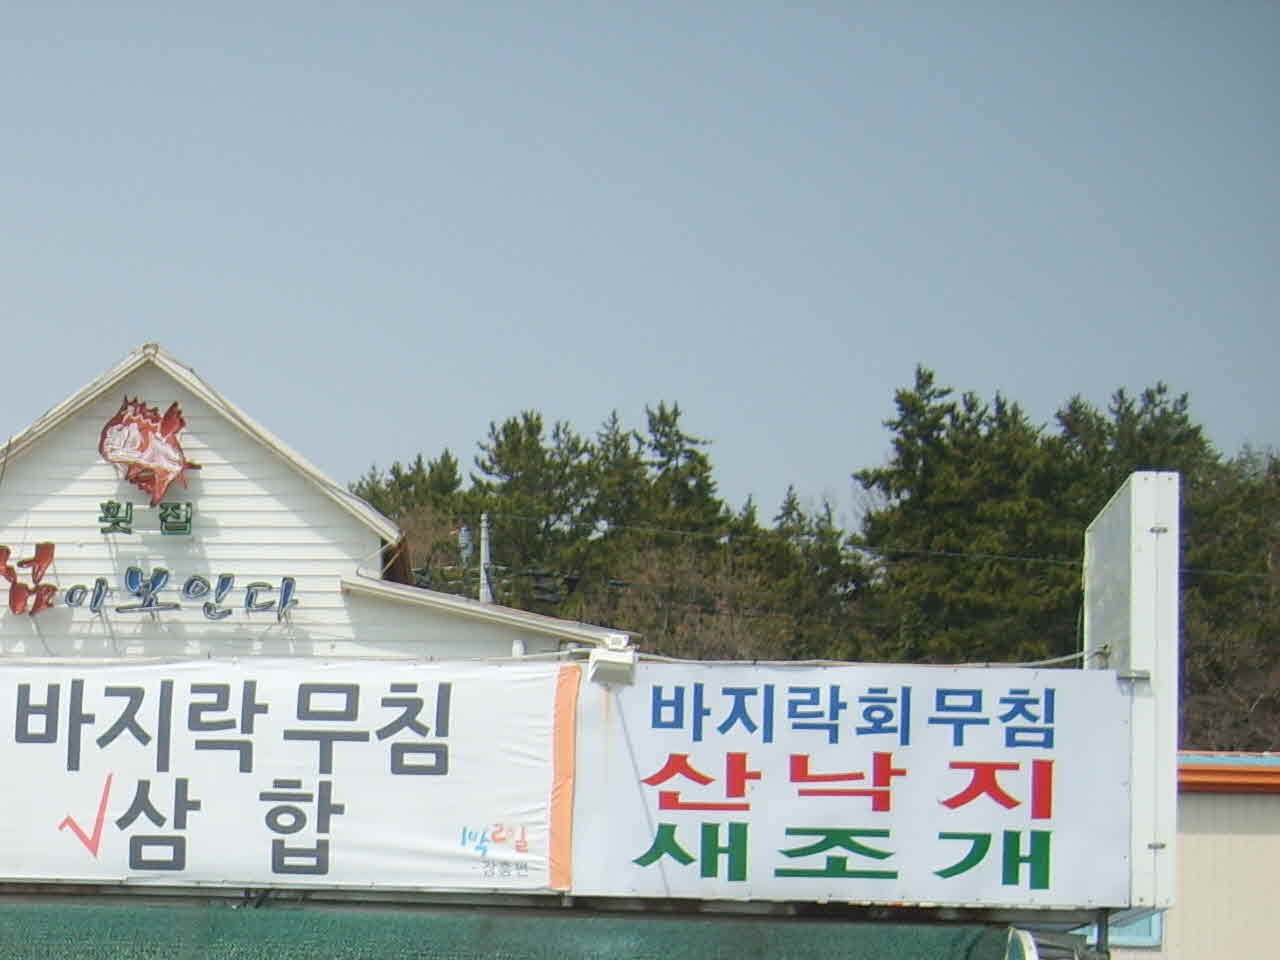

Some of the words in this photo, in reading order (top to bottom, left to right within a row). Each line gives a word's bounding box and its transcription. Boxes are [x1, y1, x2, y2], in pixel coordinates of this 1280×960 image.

[99, 501, 193, 535] 횟집
[14, 679, 452, 776] 바지락무침
[650, 683, 1056, 749] 바지락회무침
[641, 751, 1054, 820] 산낙지
[632, 823, 1052, 890] 새조개
